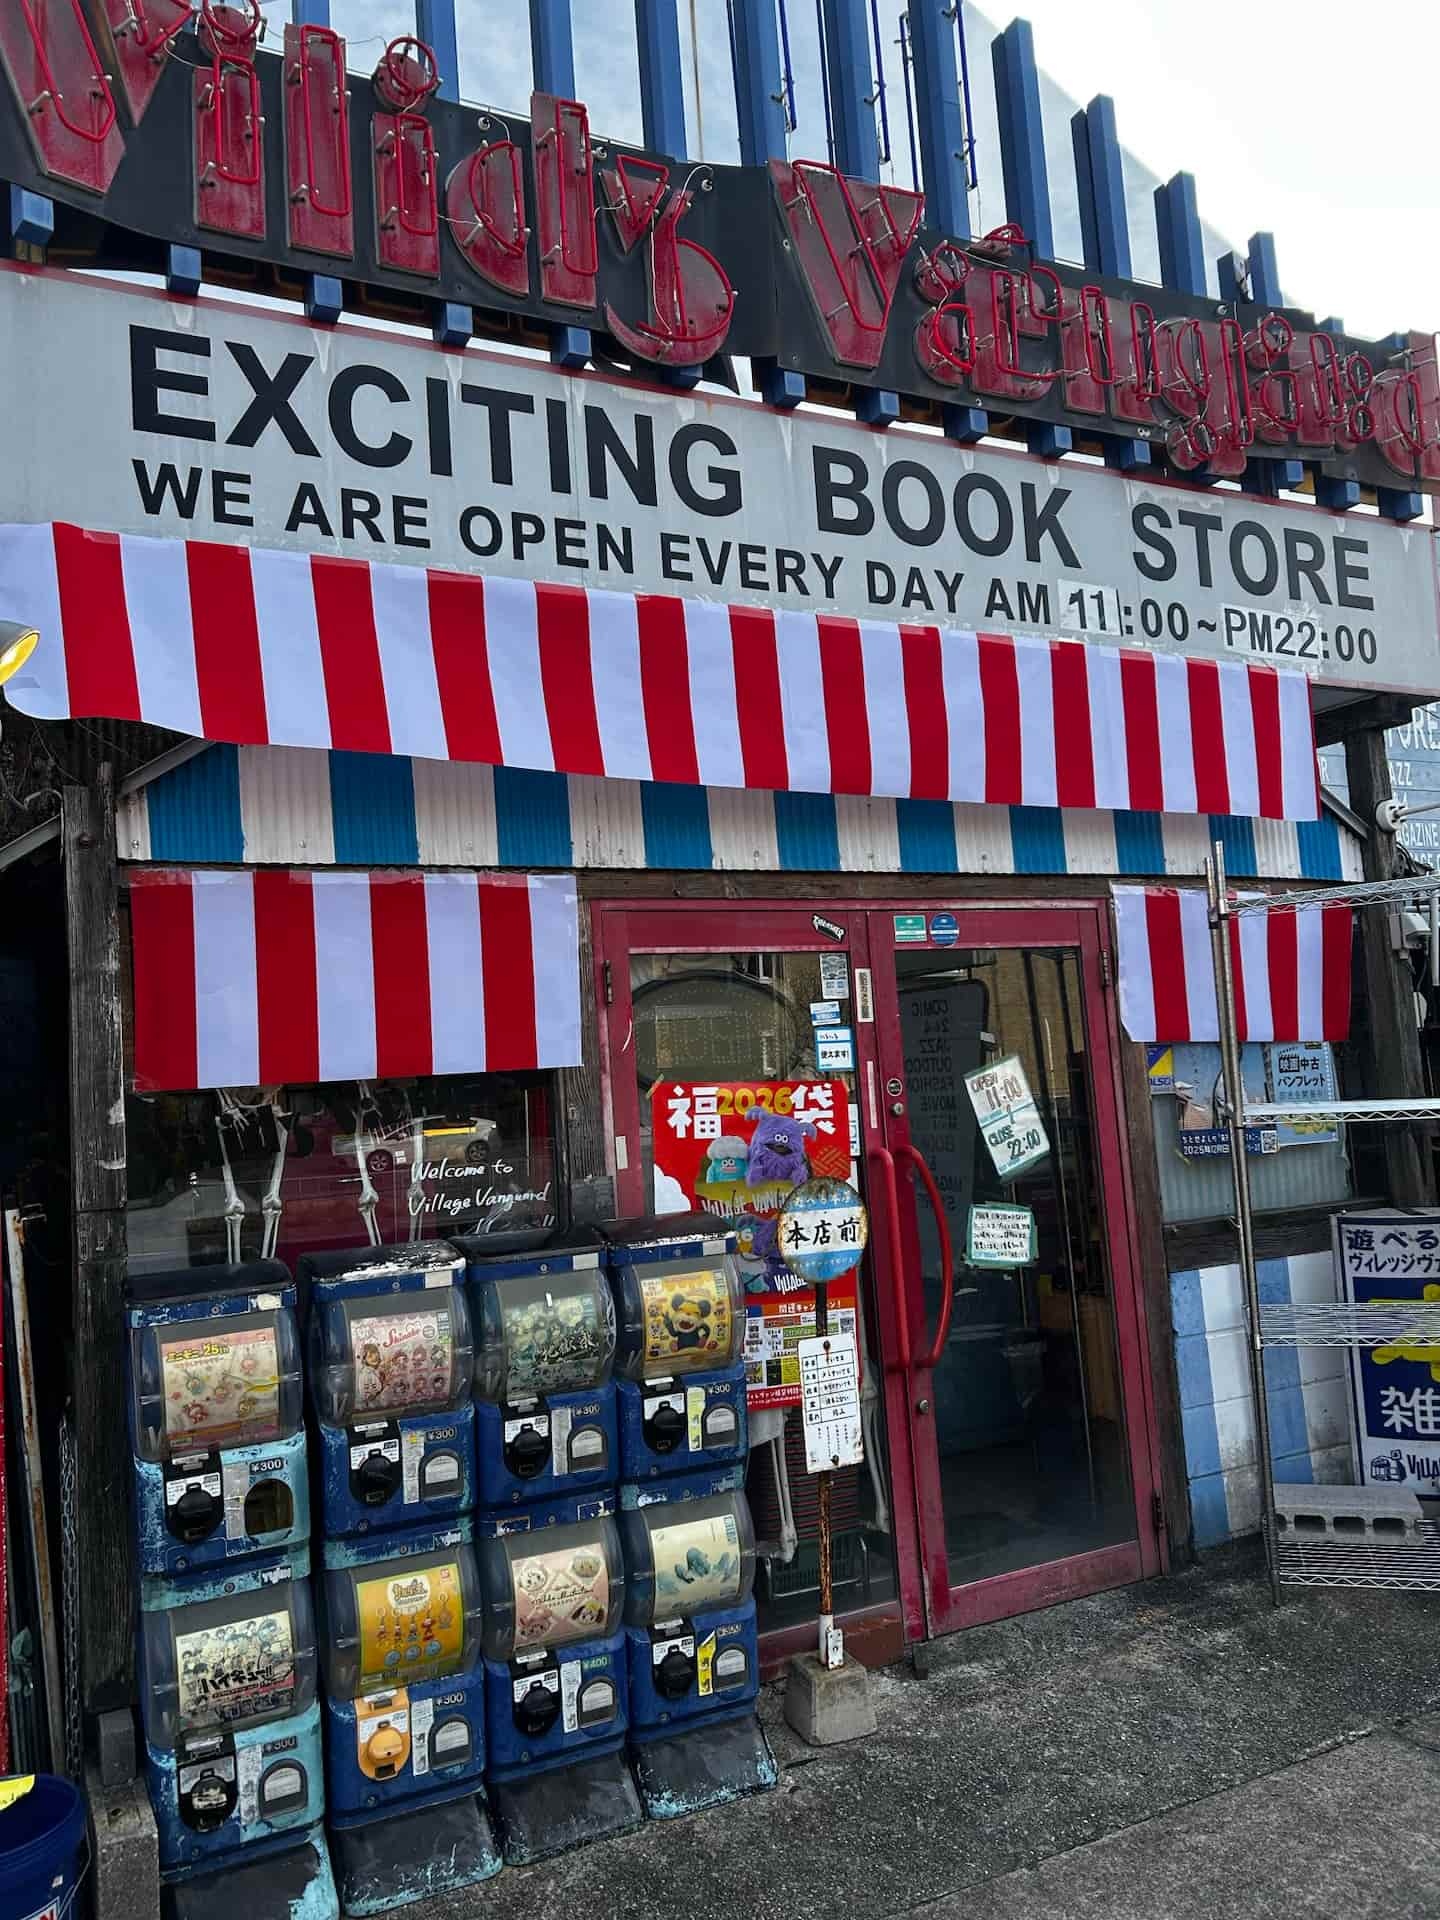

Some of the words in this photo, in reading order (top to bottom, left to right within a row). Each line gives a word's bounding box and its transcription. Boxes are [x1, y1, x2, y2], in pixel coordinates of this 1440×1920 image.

[130, 324, 743, 517] EXCITING
[812, 445, 1081, 568] BOOK
[1131, 502, 1374, 610] STORE
[132, 459, 253, 527] WE
[285, 482, 430, 548] ARE
[459, 505, 633, 573] OPEN
[661, 532, 844, 598] EVERY
[866, 560, 964, 613] DAY
[984, 578, 1050, 624] AM
[985, 1075, 1023, 1110] 11:00
[987, 1125, 1015, 1147] CLOSE
[1007, 1128, 1041, 1160] 22:00
[411, 1157, 485, 1180] Welcome
[491, 1159, 513, 1174] to
[408, 1193, 471, 1216] Village
[475, 1182, 551, 1212] Vanguard
[785, 1217, 860, 1250] 本店前
[1345, 1228, 1439, 1251] 遊べる
[1348, 1251, 1440, 1273] ヴィレッジヴ
[251, 1459, 282, 1473] ¥300
[1407, 1453, 1440, 1480] VILLA
